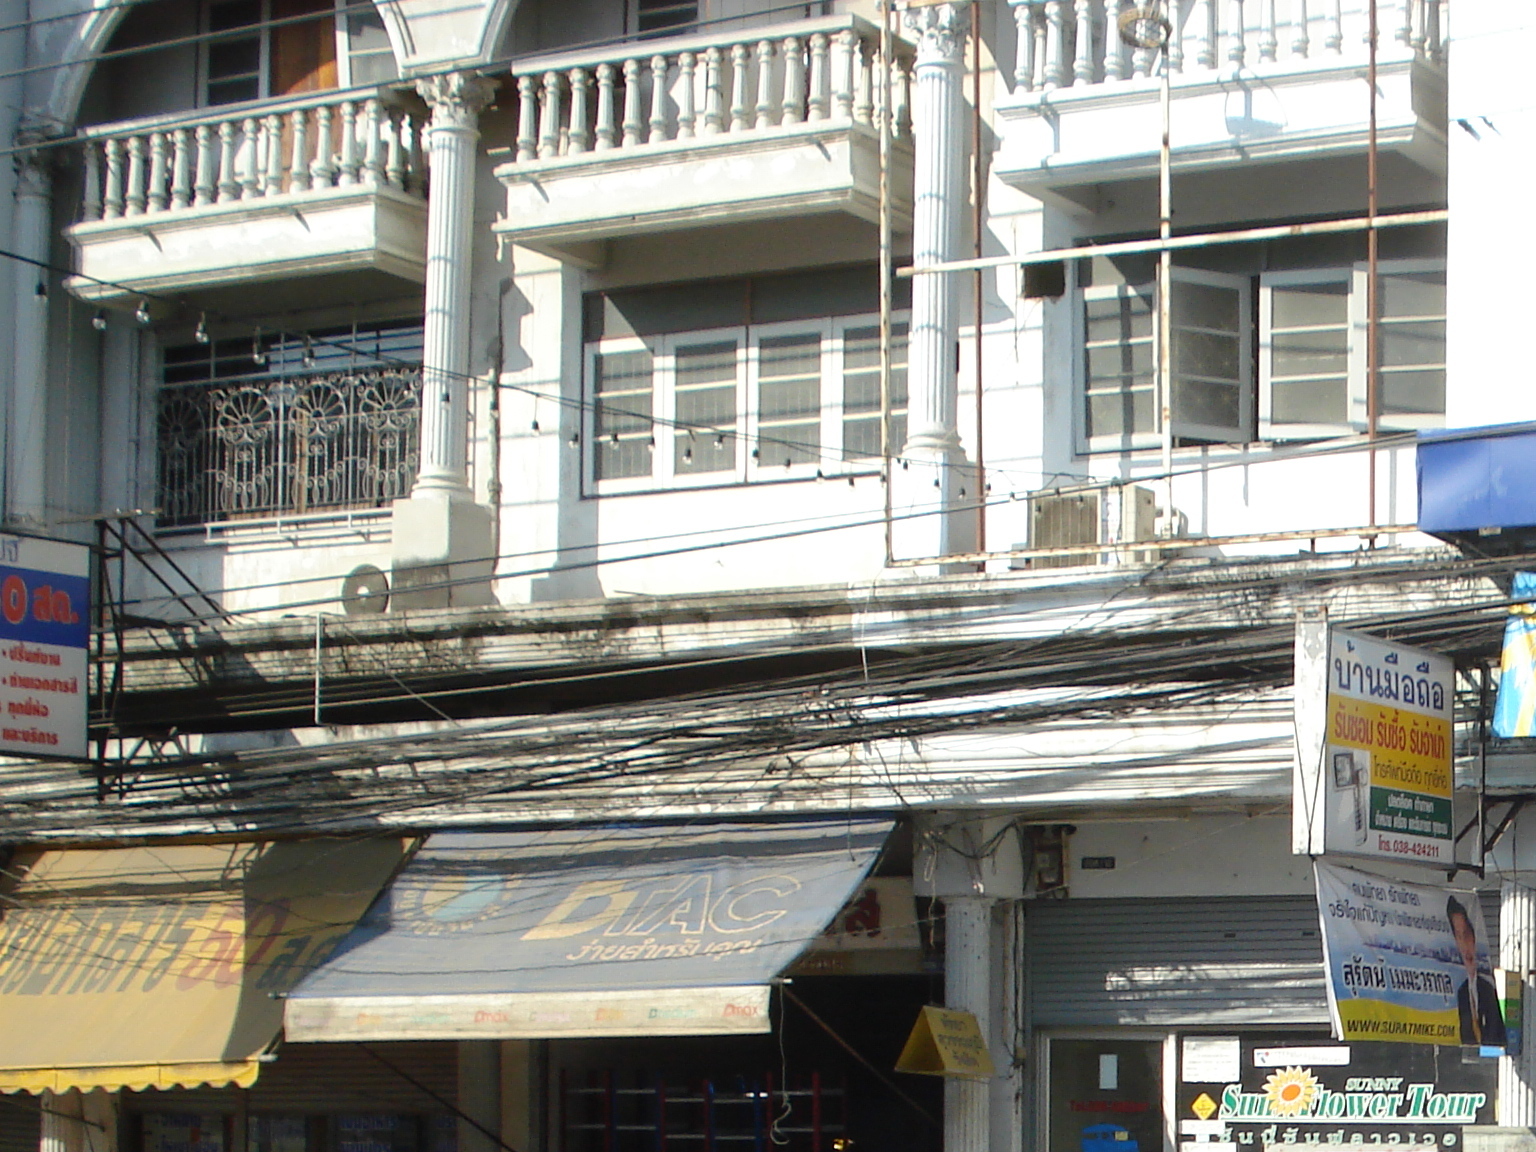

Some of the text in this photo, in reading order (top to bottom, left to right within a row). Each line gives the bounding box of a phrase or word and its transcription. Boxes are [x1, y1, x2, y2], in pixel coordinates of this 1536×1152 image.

[1334, 640, 1444, 711] บ้านมือถือ
[1334, 704, 1374, 746] รับซ่อม
[1377, 710, 1407, 752] รับซื้อ
[520, 871, 802, 942] DTAC
[566, 936, 763, 963] ง่ายสำหรับคุณ
[722, 1003, 759, 1018] Dmax
[1348, 1019, 1456, 1037] WWW.SURATMIKE.COM
[1345, 1078, 1403, 1091] SUNNY
[1405, 1083, 1487, 1118] Tour
